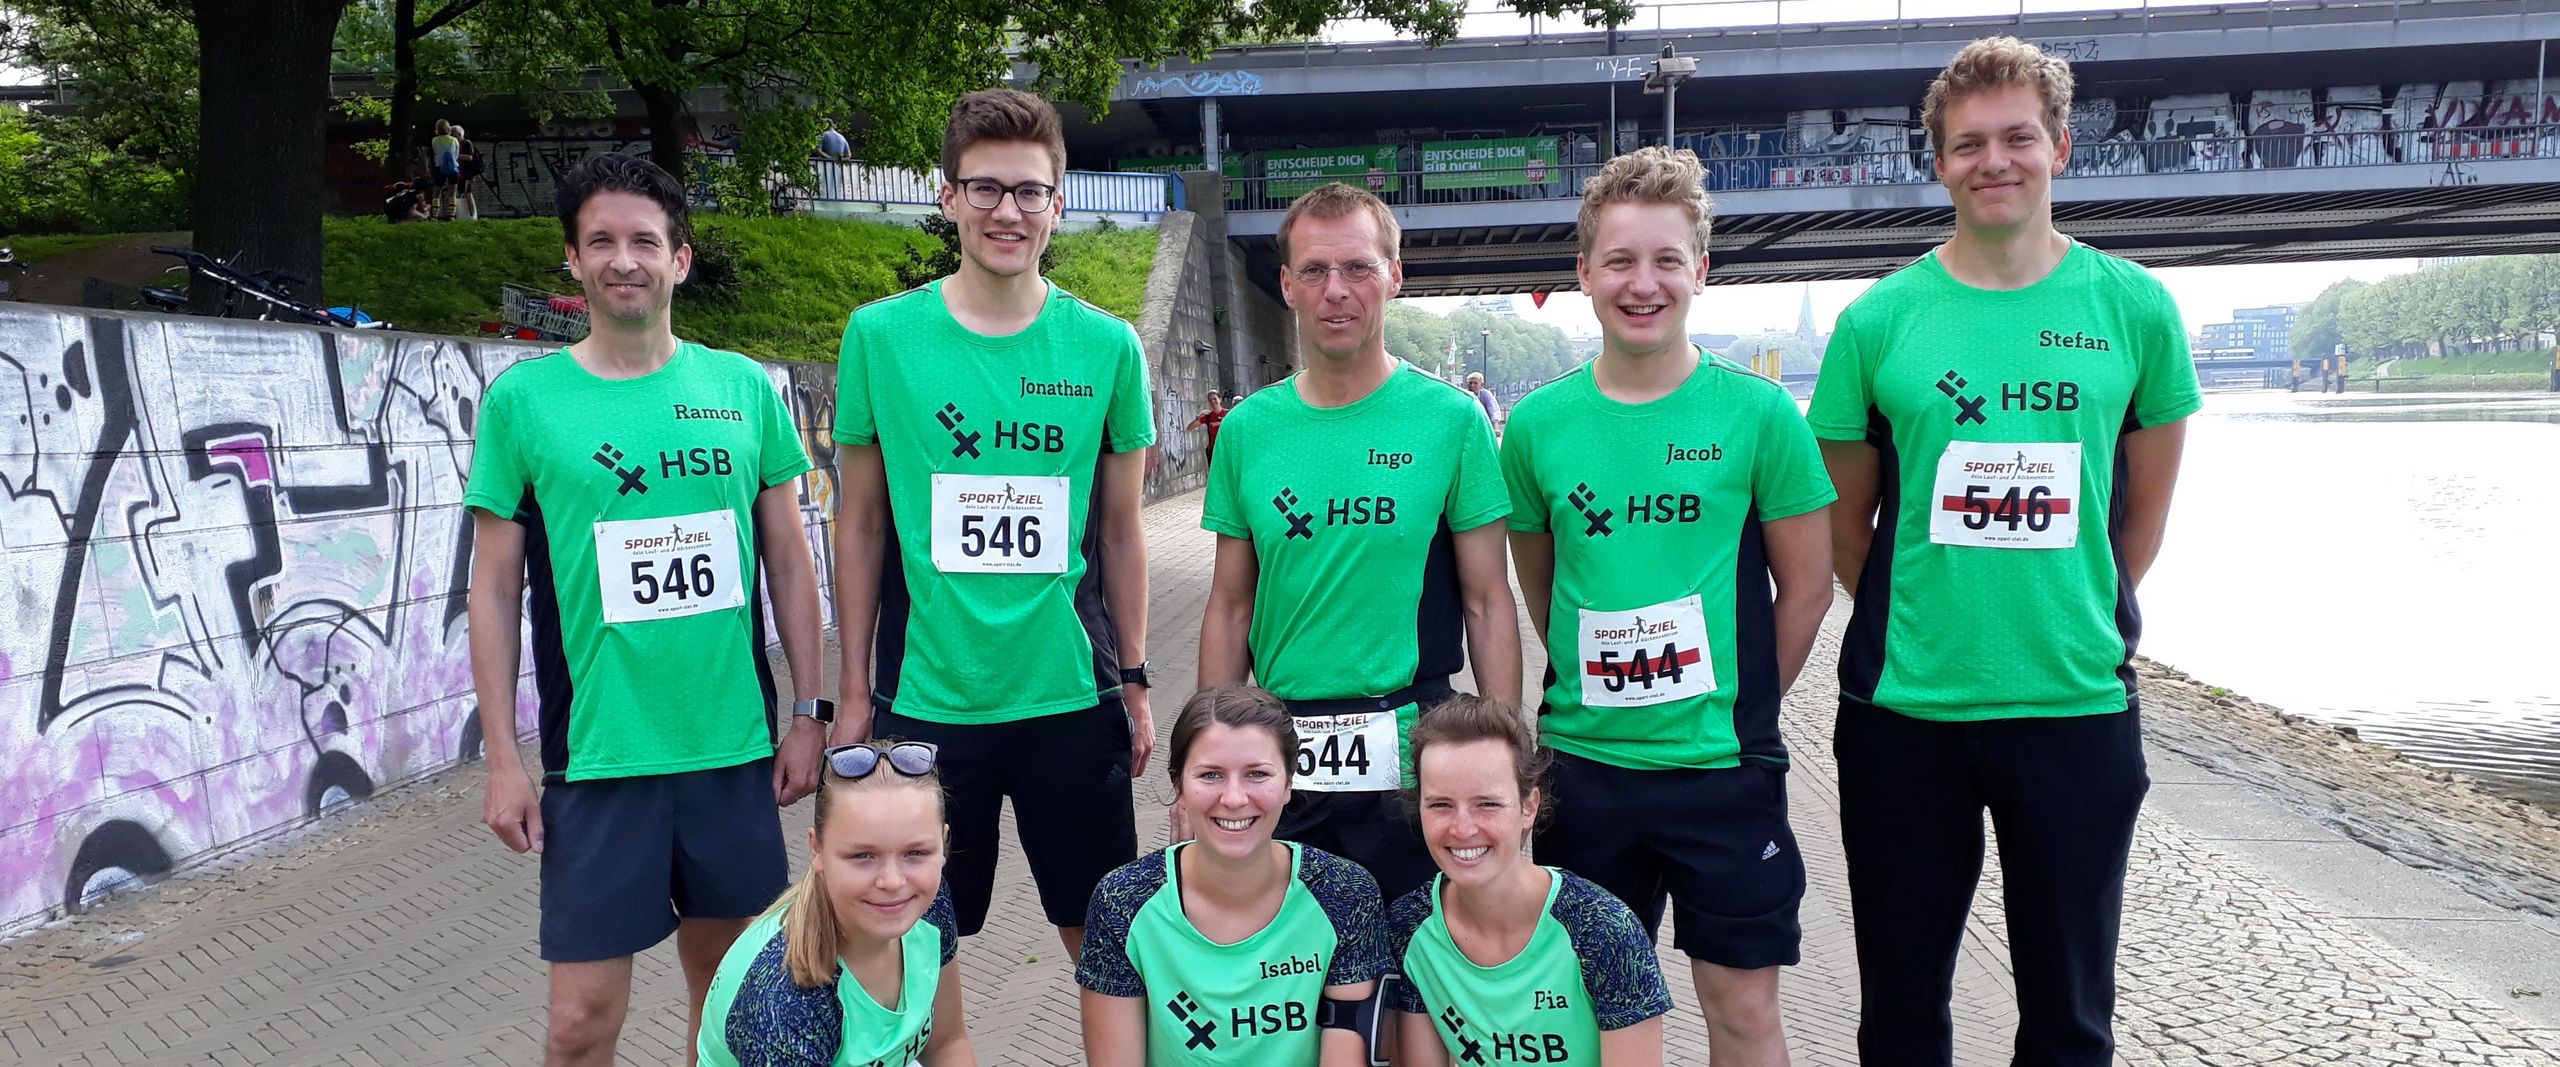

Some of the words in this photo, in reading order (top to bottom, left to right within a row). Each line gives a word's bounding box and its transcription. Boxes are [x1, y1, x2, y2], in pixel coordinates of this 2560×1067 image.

[1267, 156, 1335, 170] ENTSCHEIDE
[1338, 154, 1365, 167] DICH
[1424, 147, 1495, 161] ENTSCHEIDE
[1497, 146, 1526, 158] DICH
[1267, 170, 1289, 183] FÜR
[1291, 169, 1323, 181] DICH!
[1424, 160, 1447, 172] FÜR
[1449, 161, 1482, 172] DICH!
[2039, 330, 2110, 351] Stefan
[1020, 377, 1094, 398] Jonathan
[2002, 381, 2080, 412] HSB
[673, 404, 743, 421] Ramon
[994, 420, 1065, 453] HSB
[659, 448, 733, 479] HSB
[1367, 448, 1413, 470] Ingo
[1665, 443, 1723, 465] Jacob
[1963, 461, 2015, 474] SPORT
[2026, 462, 2055, 474] ZIEL
[958, 493, 1005, 504] SPORT
[1015, 494, 1043, 505] ZIEL
[1627, 494, 1701, 524] HSB
[1963, 485, 2051, 532] 546
[1327, 496, 1396, 526] HSB
[624, 536, 673, 550] SPORT
[684, 531, 711, 544] ZIEL
[961, 514, 1042, 559] 546
[631, 553, 715, 605] 546
[1594, 628, 1636, 640] SPORT
[1648, 620, 1678, 635] ZIEL
[1600, 642, 1684, 693] 544
[1295, 720, 1331, 730] SPORT
[1343, 714, 1370, 727] ZIEL
[1297, 734, 1370, 777] 544
[1259, 953, 1322, 980] Isabel
[1533, 991, 1569, 1010] Pia
[1231, 1001, 1308, 1038] HSB
[903, 1017, 930, 1067] HS
[1493, 1032, 1569, 1063] HSB
